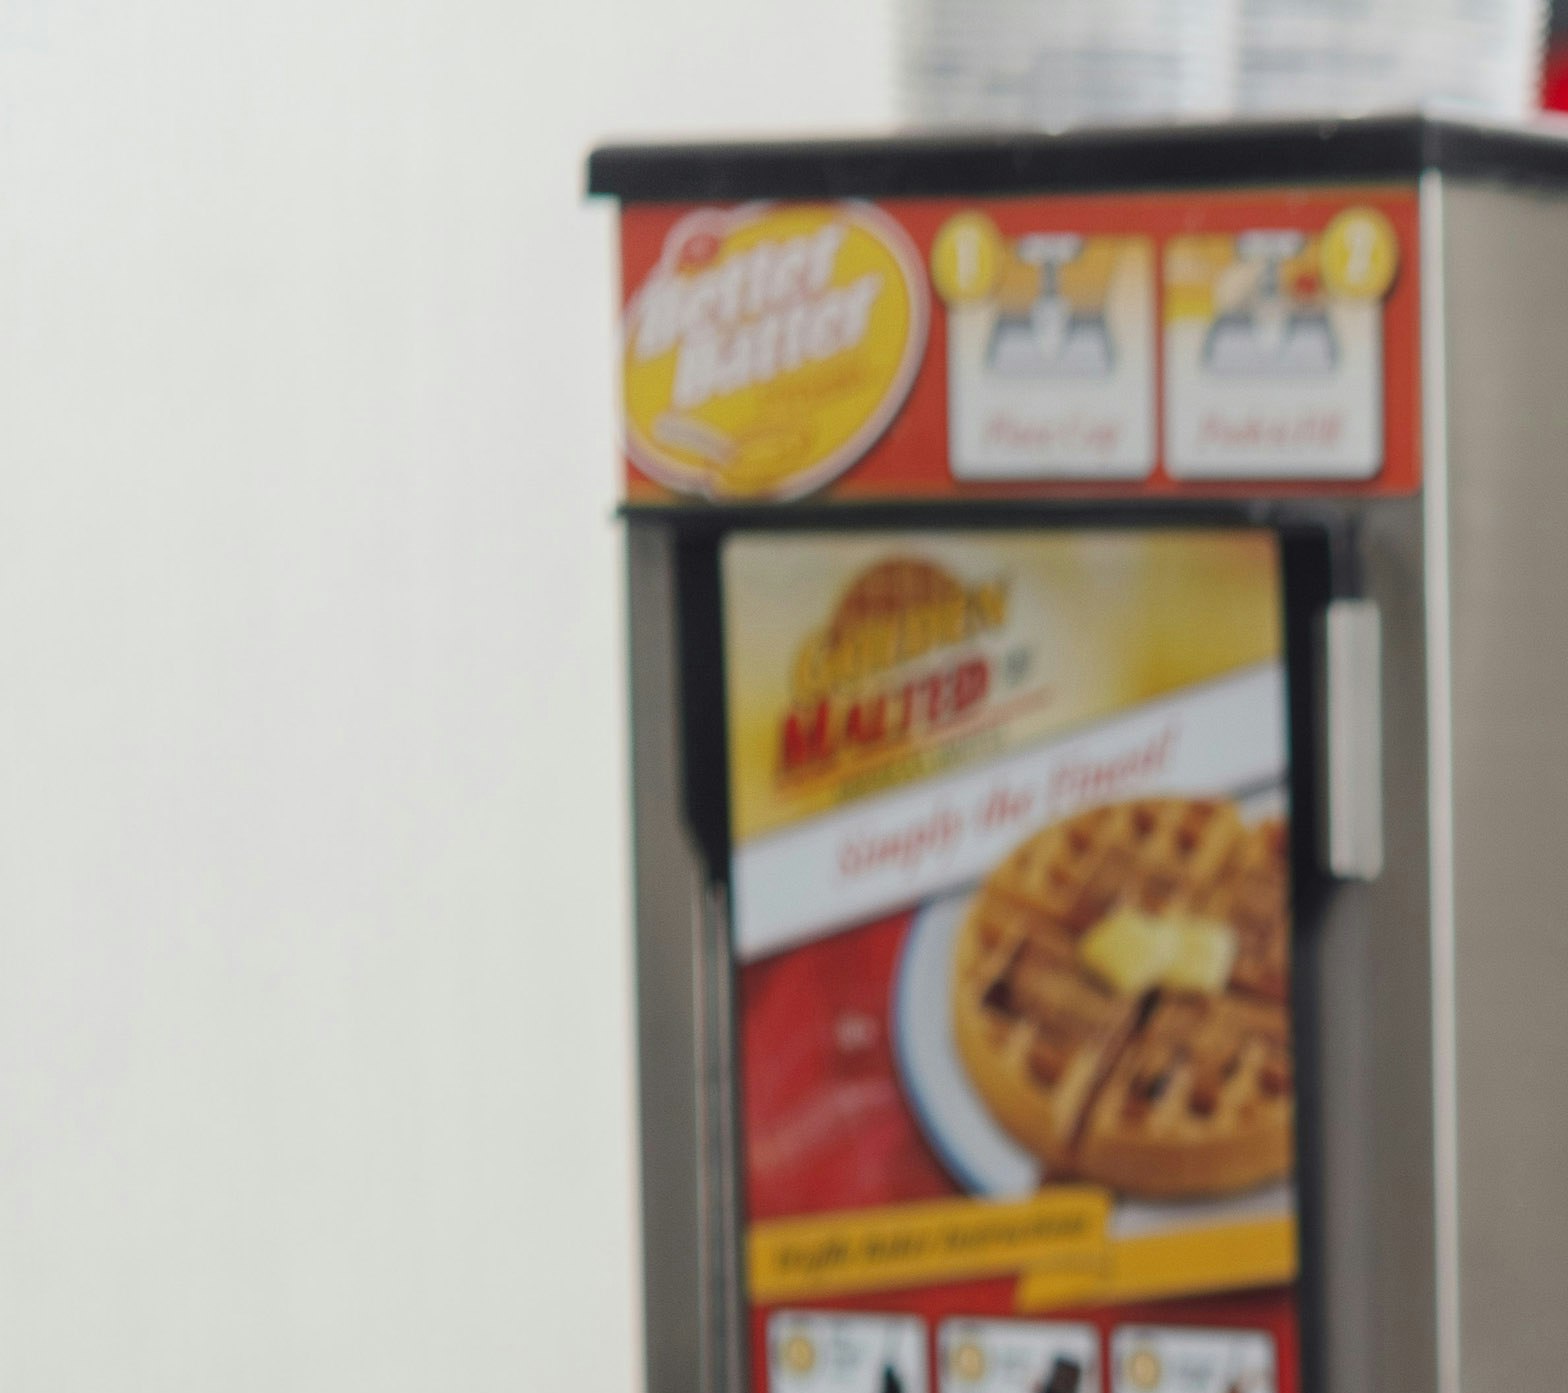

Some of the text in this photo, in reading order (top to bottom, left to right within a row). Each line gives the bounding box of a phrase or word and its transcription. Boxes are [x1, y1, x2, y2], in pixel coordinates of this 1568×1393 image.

[954, 221, 981, 291] 1
[1346, 217, 1378, 285] 2
[777, 656, 991, 774] MALTED
